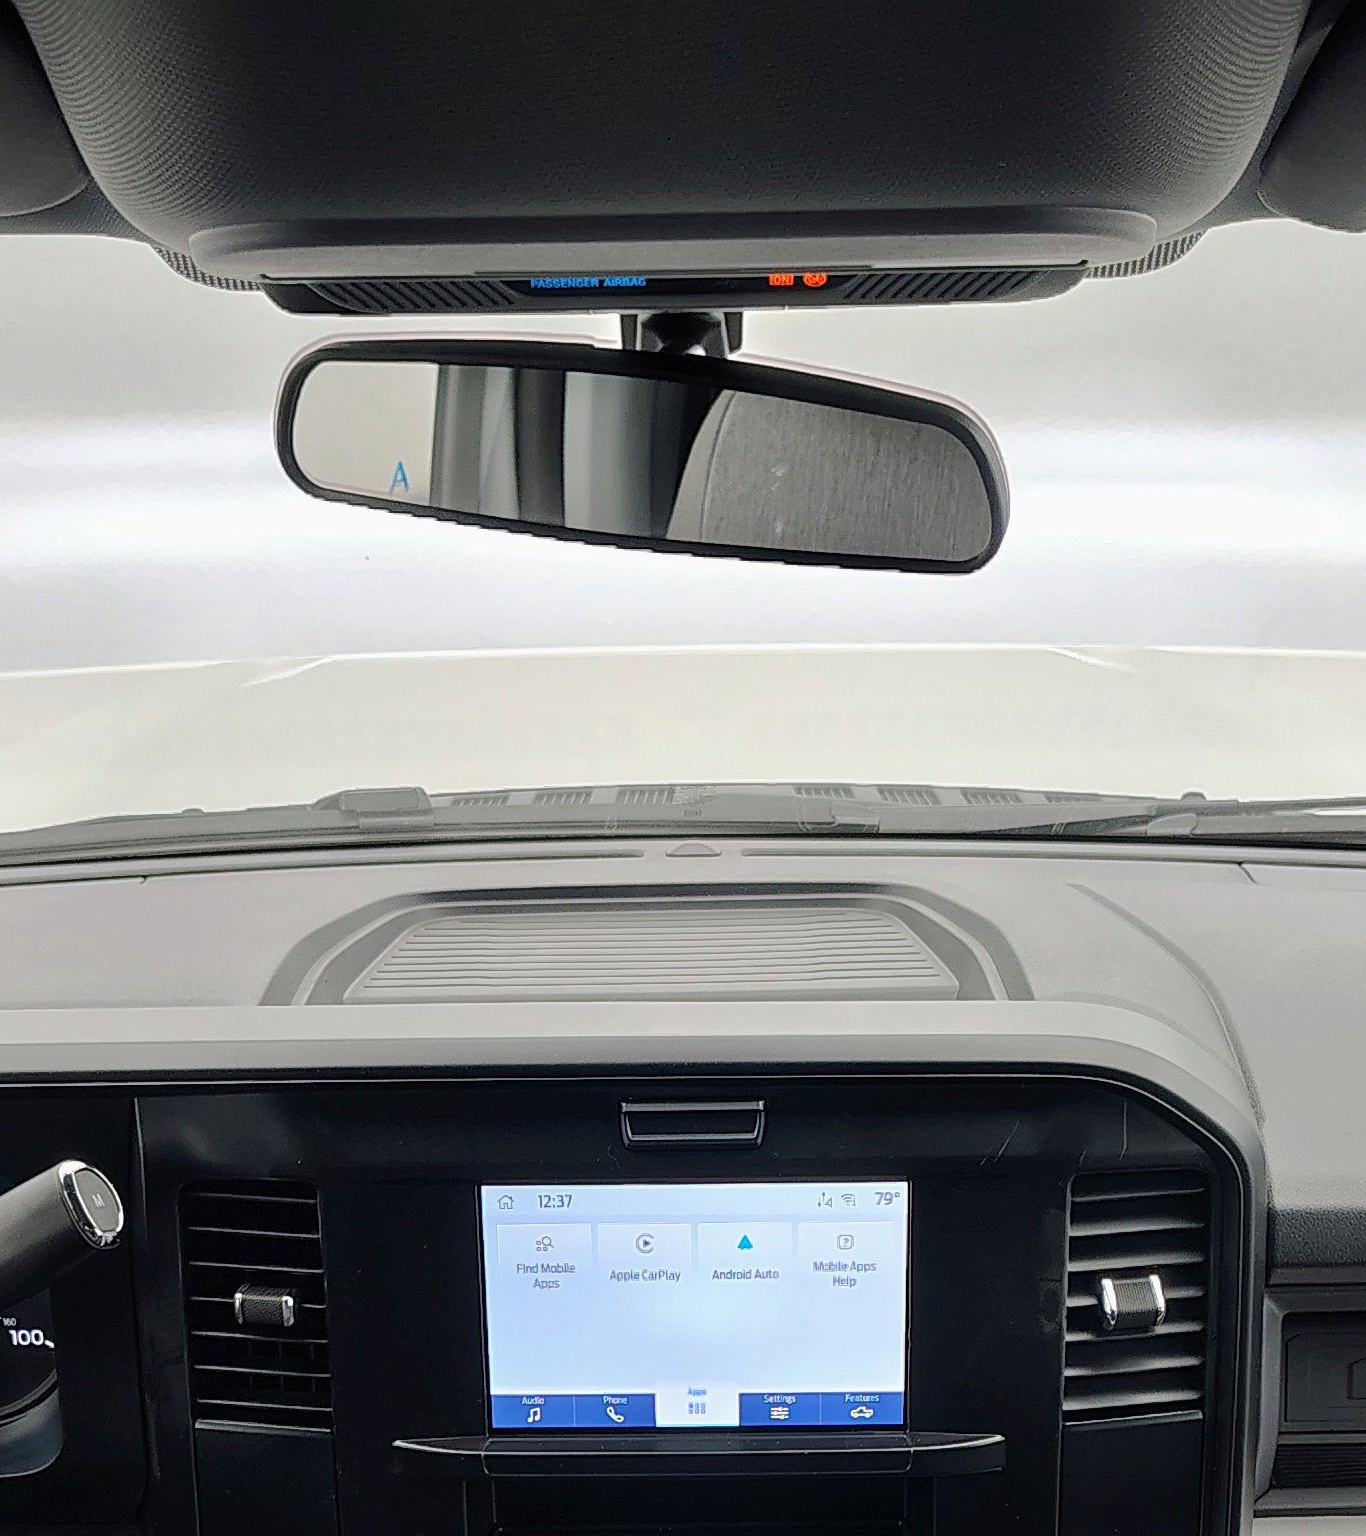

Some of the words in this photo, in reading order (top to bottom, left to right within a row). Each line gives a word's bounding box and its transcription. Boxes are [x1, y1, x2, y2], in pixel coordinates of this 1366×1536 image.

[530, 278, 599, 289] PASSENGER
[603, 277, 647, 288] AIRBAG
[91, 1193, 106, 1208] M
[537, 1194, 573, 1209] 12:37
[516, 1263, 539, 1274] Find
[540, 1262, 576, 1274] Mobile
[812, 1261, 849, 1272] Mobile
[850, 1261, 877, 1273] Apps
[609, 1270, 640, 1282] Apple
[641, 1269, 681, 1282] CarPlay
[712, 1269, 752, 1280] Android
[754, 1269, 780, 1280] Auto
[533, 1278, 561, 1290] Apps
[832, 1277, 858, 1288] Help
[8, 1329, 44, 1347] 100
[521, 1396, 545, 1406] Audio
[603, 1395, 628, 1405] Phone
[763, 1394, 797, 1404] Settings
[845, 1393, 880, 1403] Features
